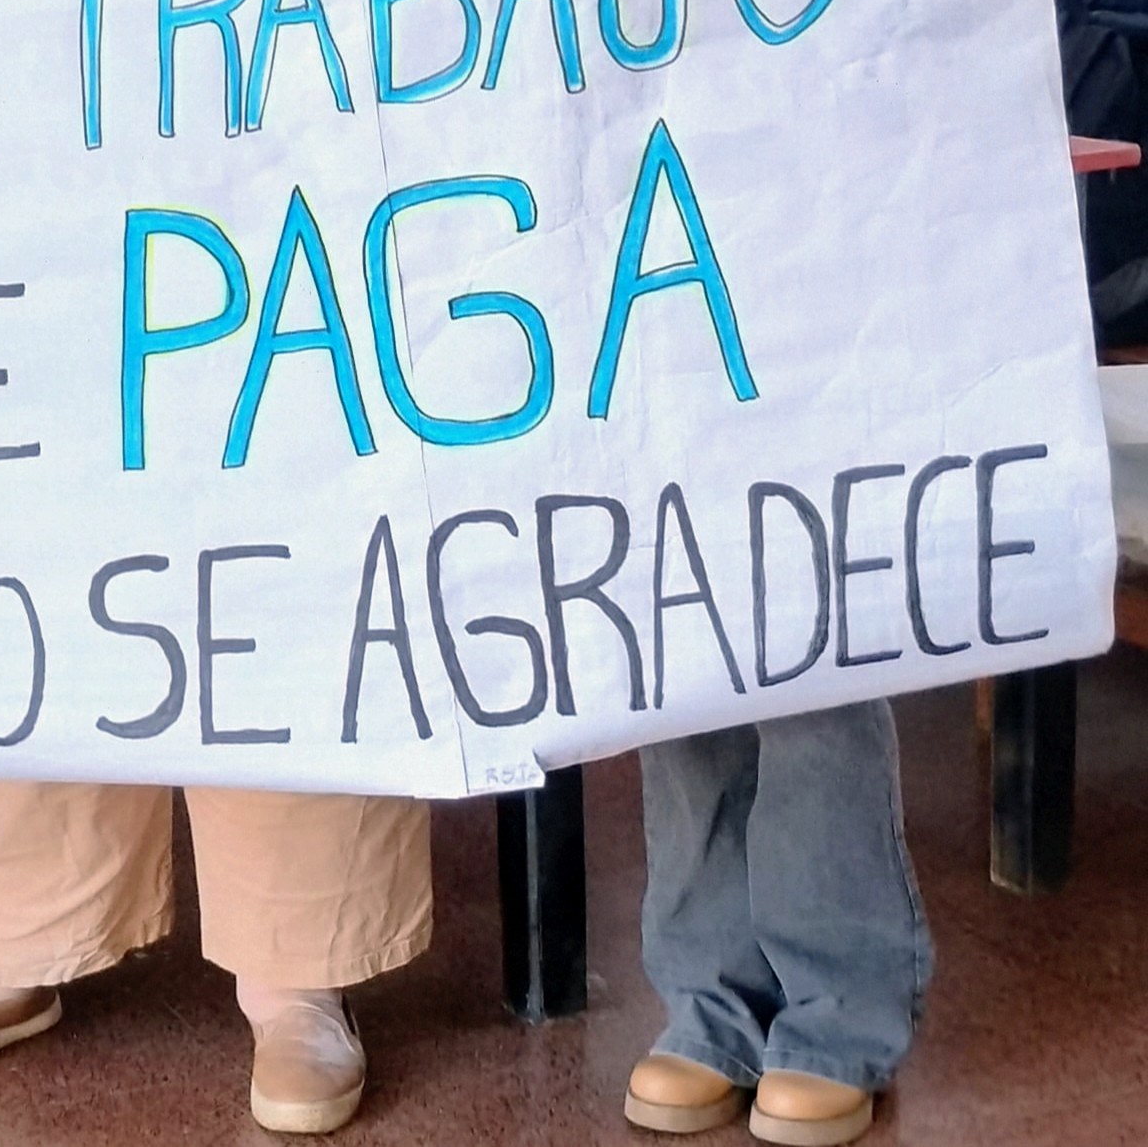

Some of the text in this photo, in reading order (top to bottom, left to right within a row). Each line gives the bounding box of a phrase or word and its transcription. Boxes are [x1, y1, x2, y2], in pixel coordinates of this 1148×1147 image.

[121, 118, 759, 471] PAGA
[88, 544, 292, 744] SE
[344, 443, 1049, 745] AGRADECE
